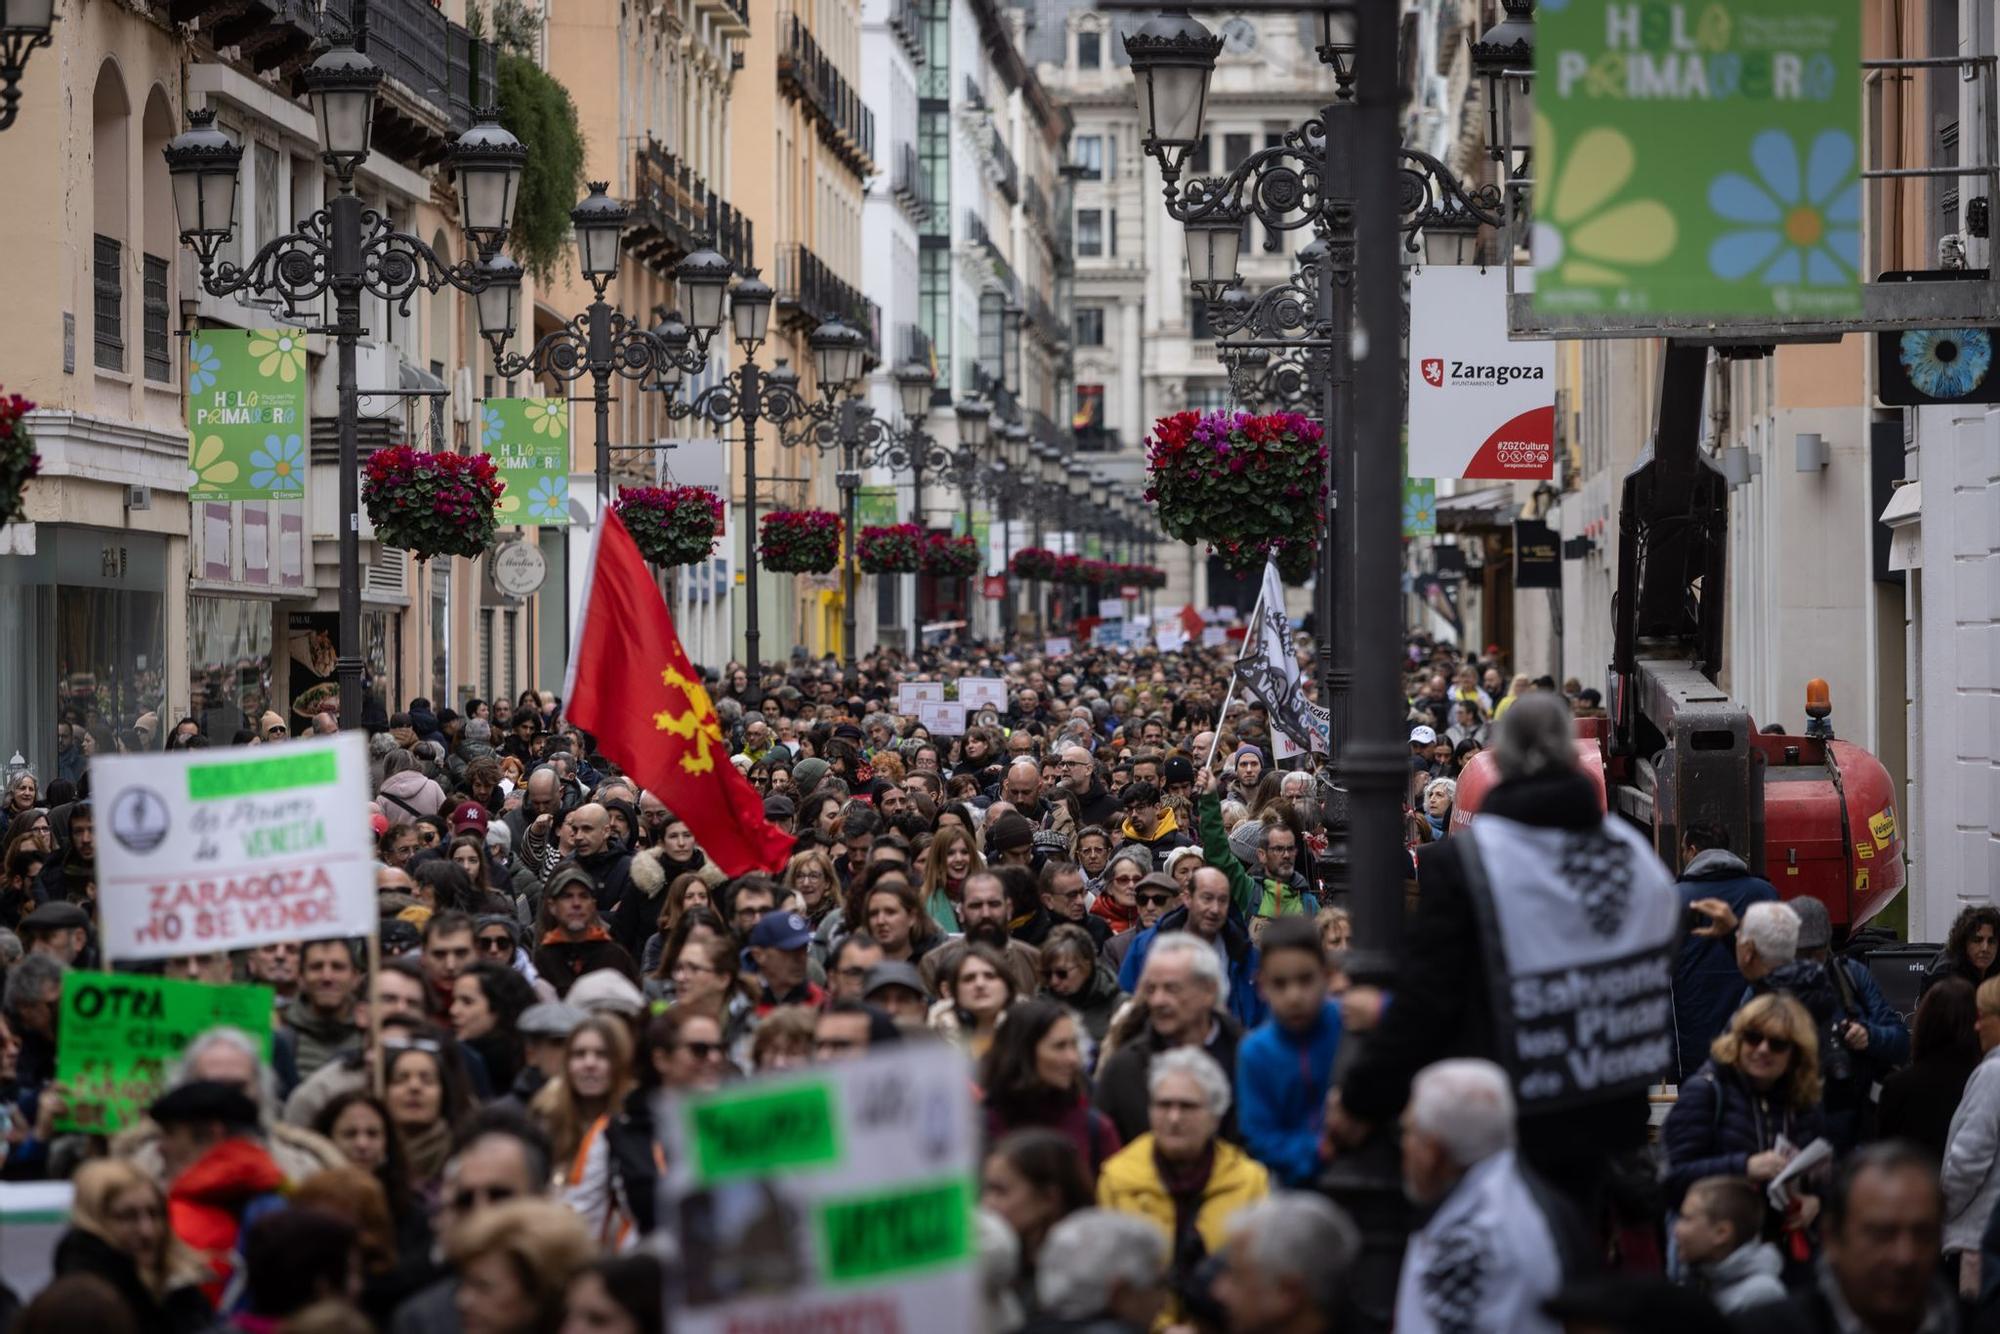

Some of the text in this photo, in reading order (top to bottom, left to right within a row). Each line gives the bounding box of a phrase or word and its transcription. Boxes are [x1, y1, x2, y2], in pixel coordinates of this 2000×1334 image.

[1604, 3, 1731, 50] HOLA
[1556, 50, 1835, 101] PRIMAVERA
[1451, 361, 1544, 385] Zaragoza
[214, 390, 258, 408] HOLA
[197, 407, 295, 425] PRIMAVERA
[501, 443, 534, 457] HOLA
[1497, 441, 1549, 451] #ZGZCultura
[489, 455, 561, 470] PRIMAVERA
[148, 865, 335, 912] ZARAGOZA
[133, 912, 183, 943] NO
[72, 985, 165, 1020] OTRA
